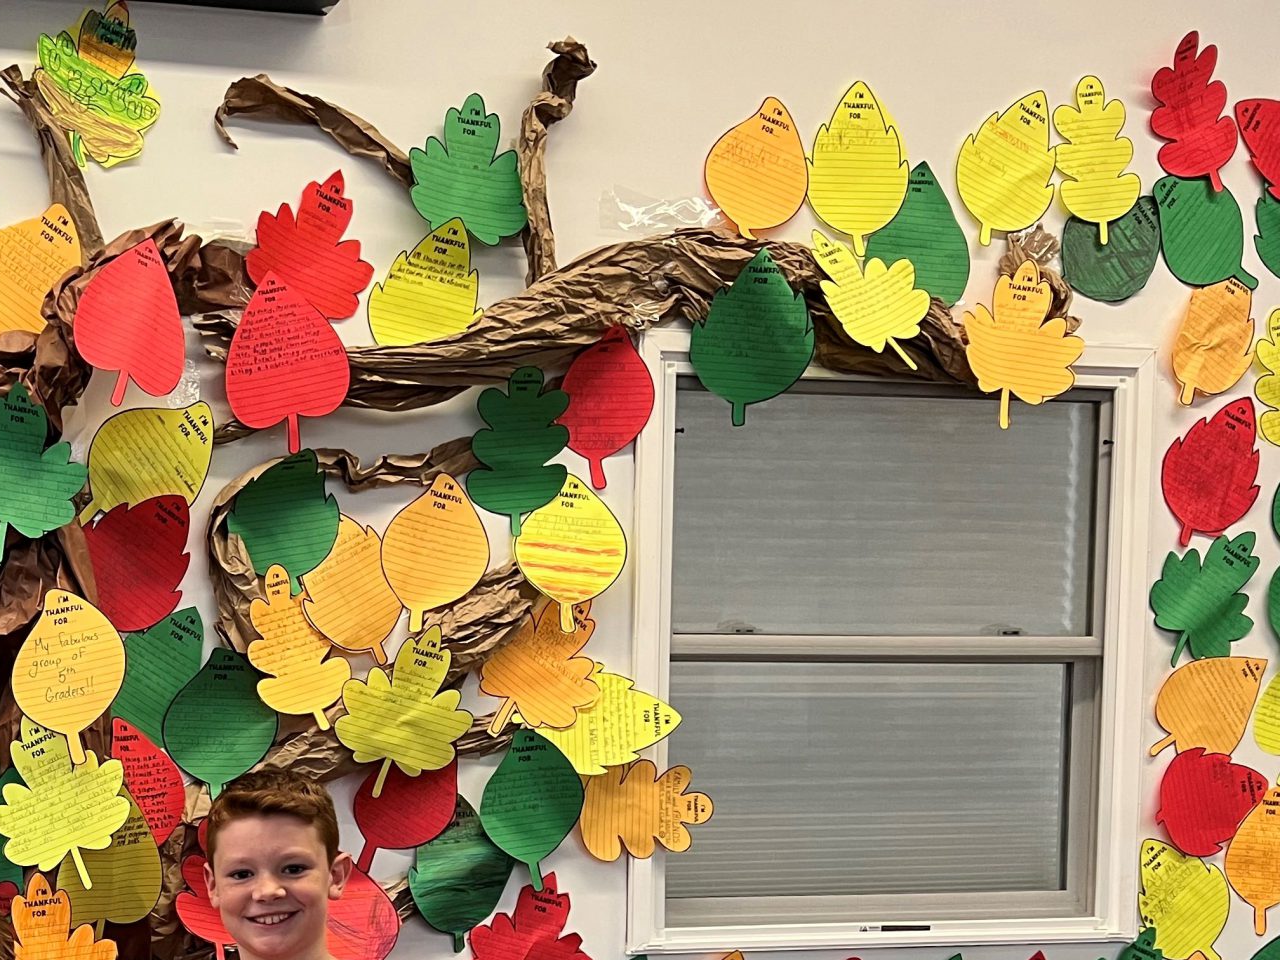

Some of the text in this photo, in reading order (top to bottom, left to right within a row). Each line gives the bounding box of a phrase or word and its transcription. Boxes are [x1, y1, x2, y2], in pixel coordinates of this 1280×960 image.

[773, 108, 782, 116] I'M
[844, 102, 874, 110] THANKFUL
[1019, 103, 1045, 124] THANKFUL
[457, 117, 492, 128] THANKFUL
[760, 113, 789, 131] THANKFUL
[330, 185, 340, 194] I'M
[316, 189, 347, 210] THANKFUL
[58, 216, 68, 226] I'M
[41, 216, 73, 244] THANKFUL
[432, 235, 466, 249] THANKFUL
[1009, 283, 1044, 294] THANKFUL
[182, 411, 208, 444] THANKFUL
[199, 415, 208, 426] I'M
[430, 490, 462, 504] THANKFUL
[559, 492, 590, 500] HANKFUL
[46, 605, 83, 616] THANKFUL
[185, 616, 195, 624] I'M
[170, 618, 201, 641] THANKFUL
[35, 637, 49, 655] My
[413, 647, 443, 661] THANKFUL
[29, 658, 61, 678] group
[58, 667, 76, 683] 5th
[653, 703, 662, 737] THANKFUL
[29, 728, 40, 736] I'M
[22, 733, 56, 751] THANKFUL
[24, 898, 62, 908] THANKFUL
